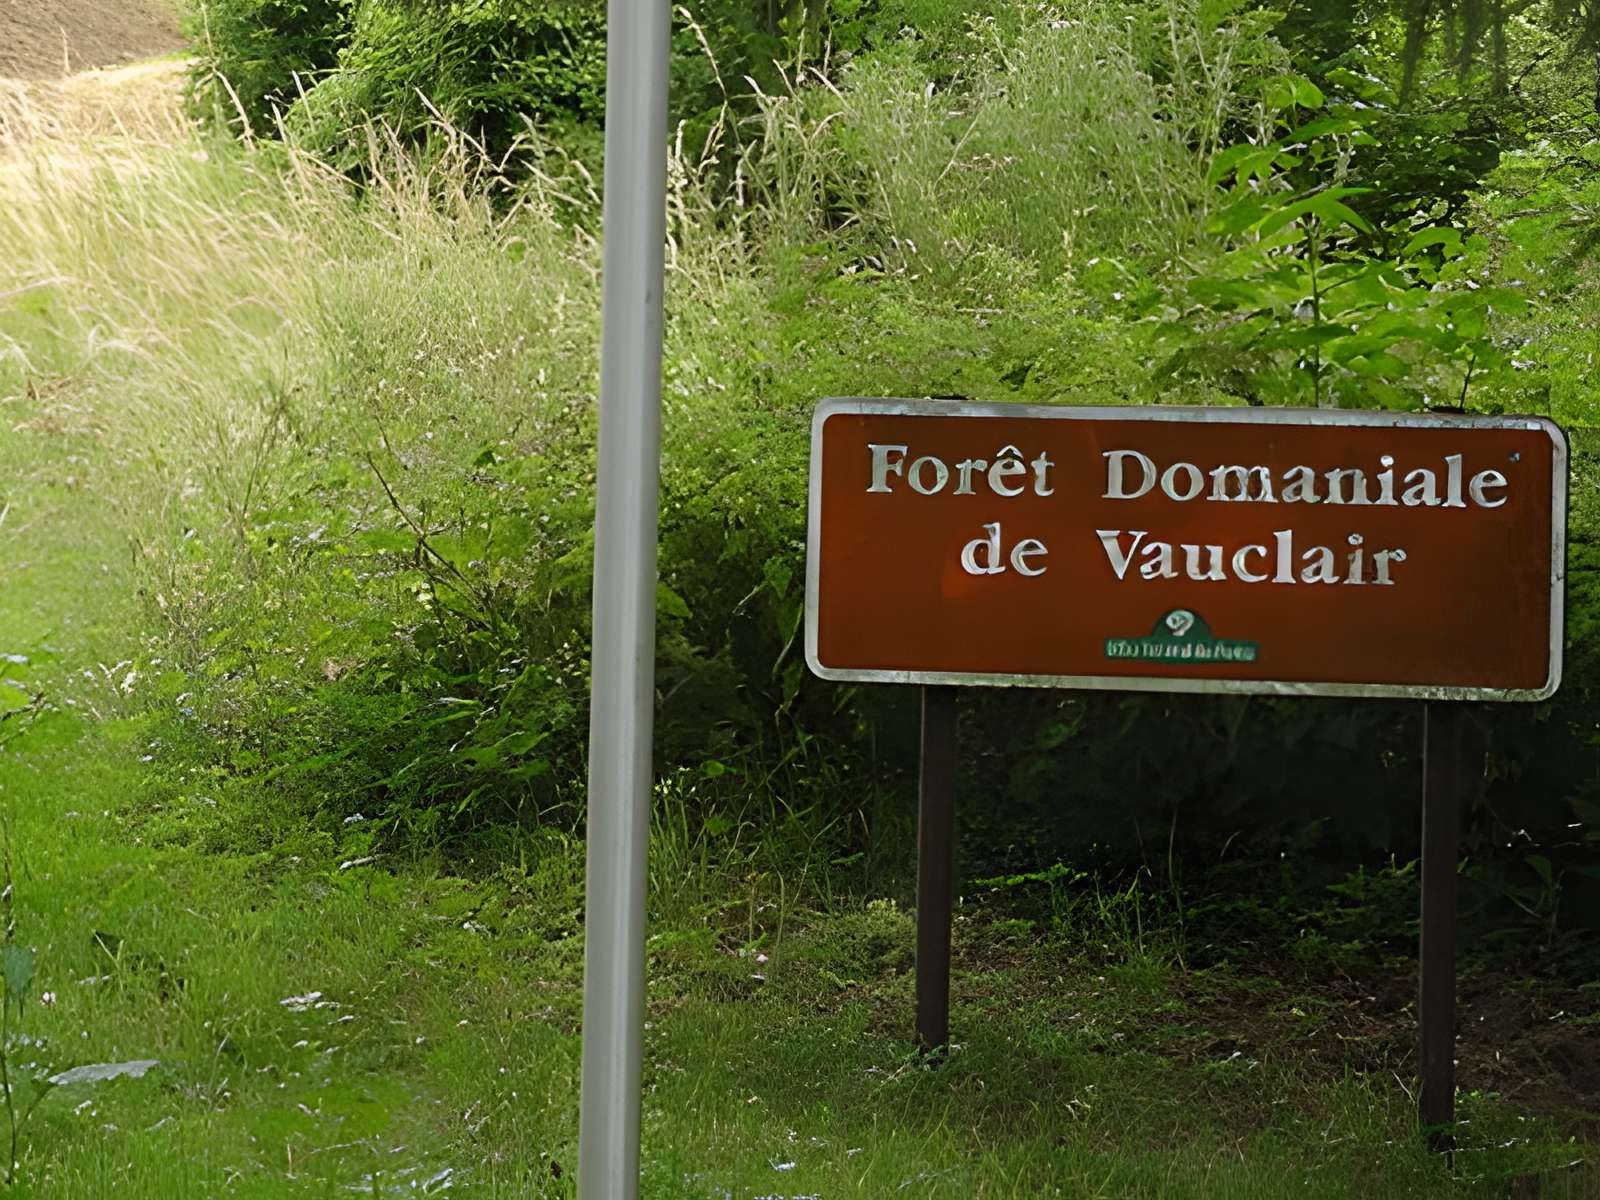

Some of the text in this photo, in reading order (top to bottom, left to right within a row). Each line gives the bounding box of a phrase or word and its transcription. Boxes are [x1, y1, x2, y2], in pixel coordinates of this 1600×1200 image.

[866, 444, 1508, 509] Forêt Domaniale
[960, 523, 1406, 586] de Vauclair
